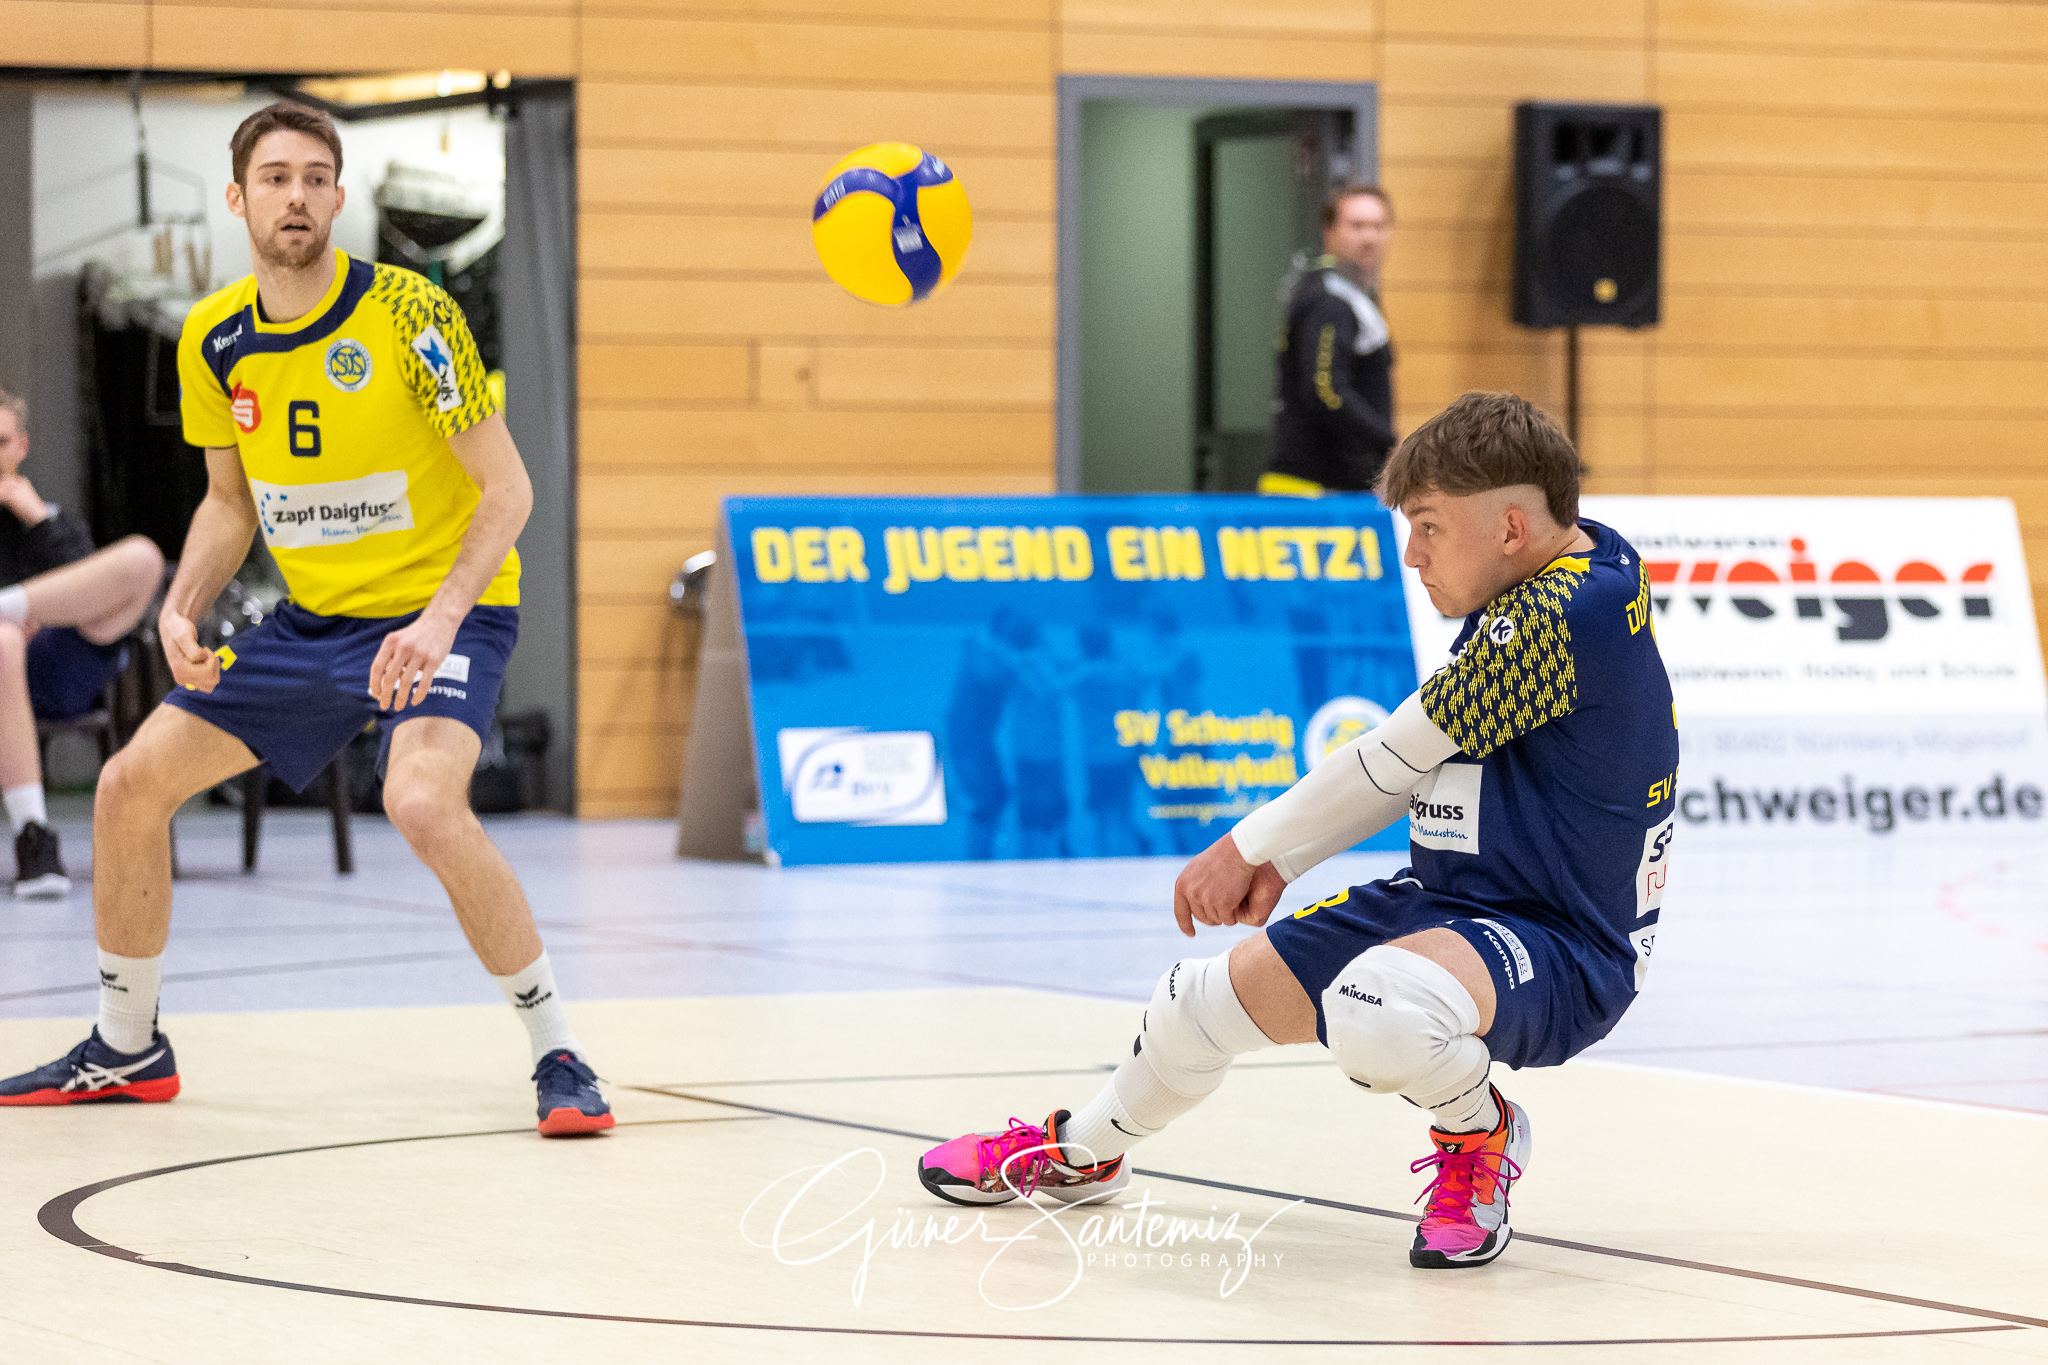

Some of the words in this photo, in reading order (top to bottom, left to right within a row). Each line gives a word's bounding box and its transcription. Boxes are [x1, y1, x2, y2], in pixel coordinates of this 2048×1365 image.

[288, 400, 321, 457] 6
[751, 526, 869, 583] DER
[883, 526, 1094, 594] JUGEND
[1107, 526, 1205, 581] EIN
[1217, 525, 1384, 581] NETZ!
[1643, 537, 1994, 642] weiger
[1646, 772, 1673, 808] SV
[1680, 776, 2045, 835] chweiger.de
[1483, 930, 1515, 990] Kempa
[1339, 984, 1383, 1007] MIKASA
